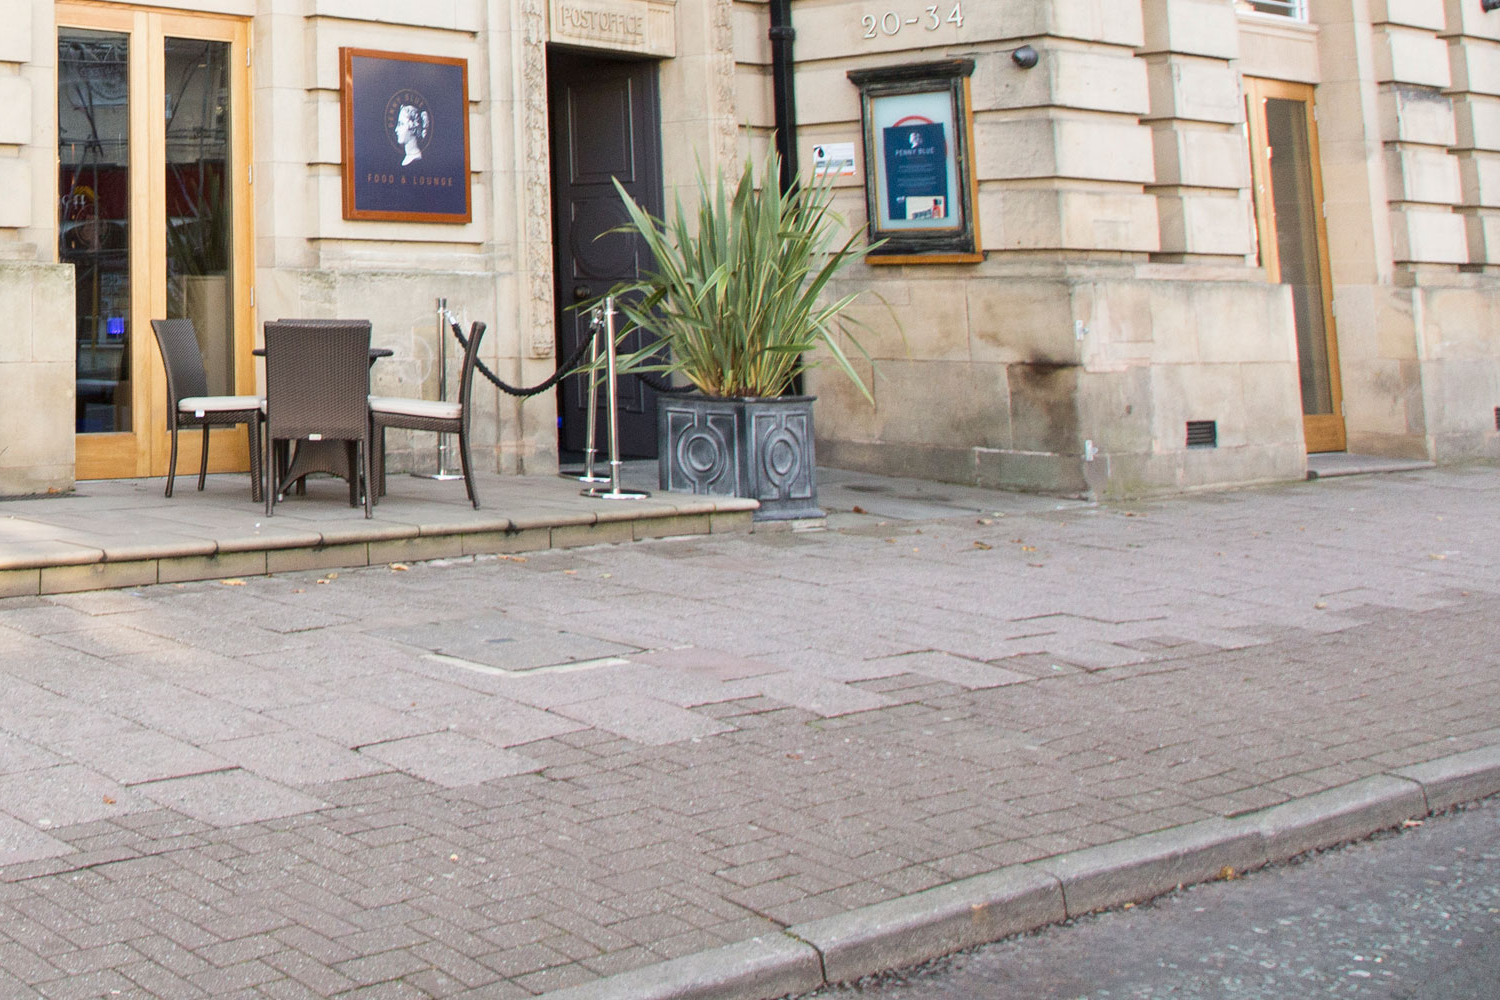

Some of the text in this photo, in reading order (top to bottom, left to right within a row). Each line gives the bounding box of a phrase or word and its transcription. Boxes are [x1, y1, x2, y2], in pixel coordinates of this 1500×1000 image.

[562, 6, 643, 36] POST OFFICE
[861, 2, 964, 38] 20-34
[895, 146, 935, 157] PENNY BLUE
[367, 173, 394, 184] FOOD
[413, 176, 453, 187] LOUNGE
